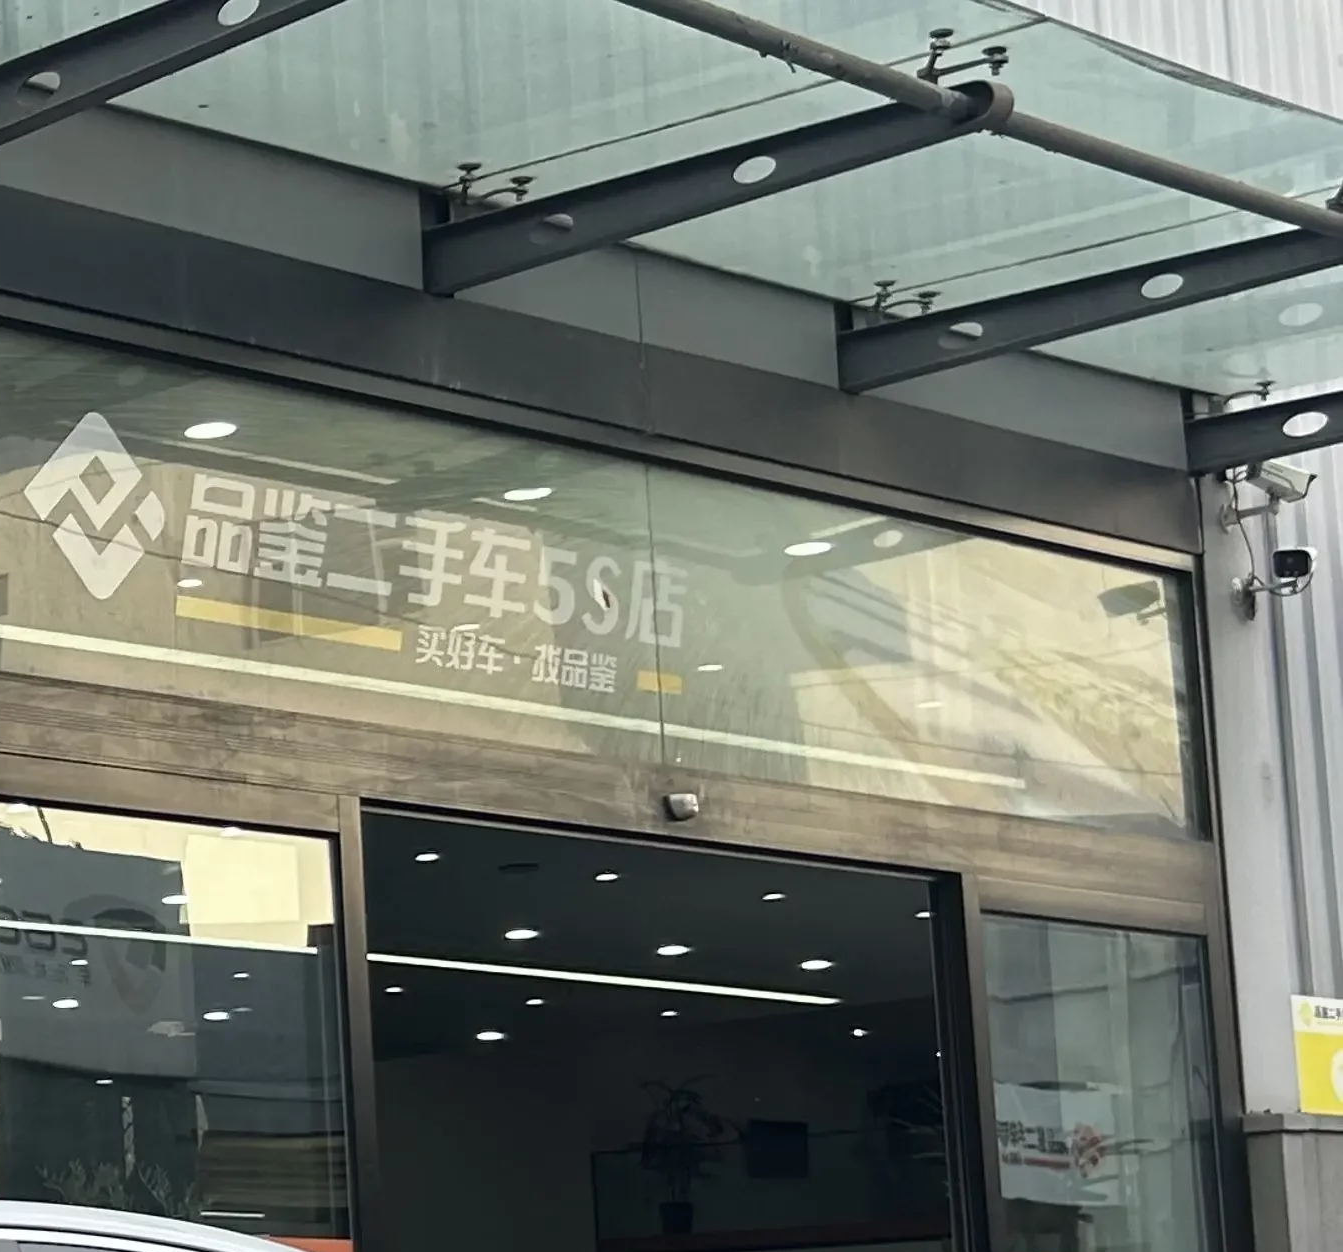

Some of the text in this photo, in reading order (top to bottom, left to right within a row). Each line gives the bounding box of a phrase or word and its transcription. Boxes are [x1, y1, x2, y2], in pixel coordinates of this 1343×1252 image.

[180, 472, 689, 649] 品鉴二手车5S店
